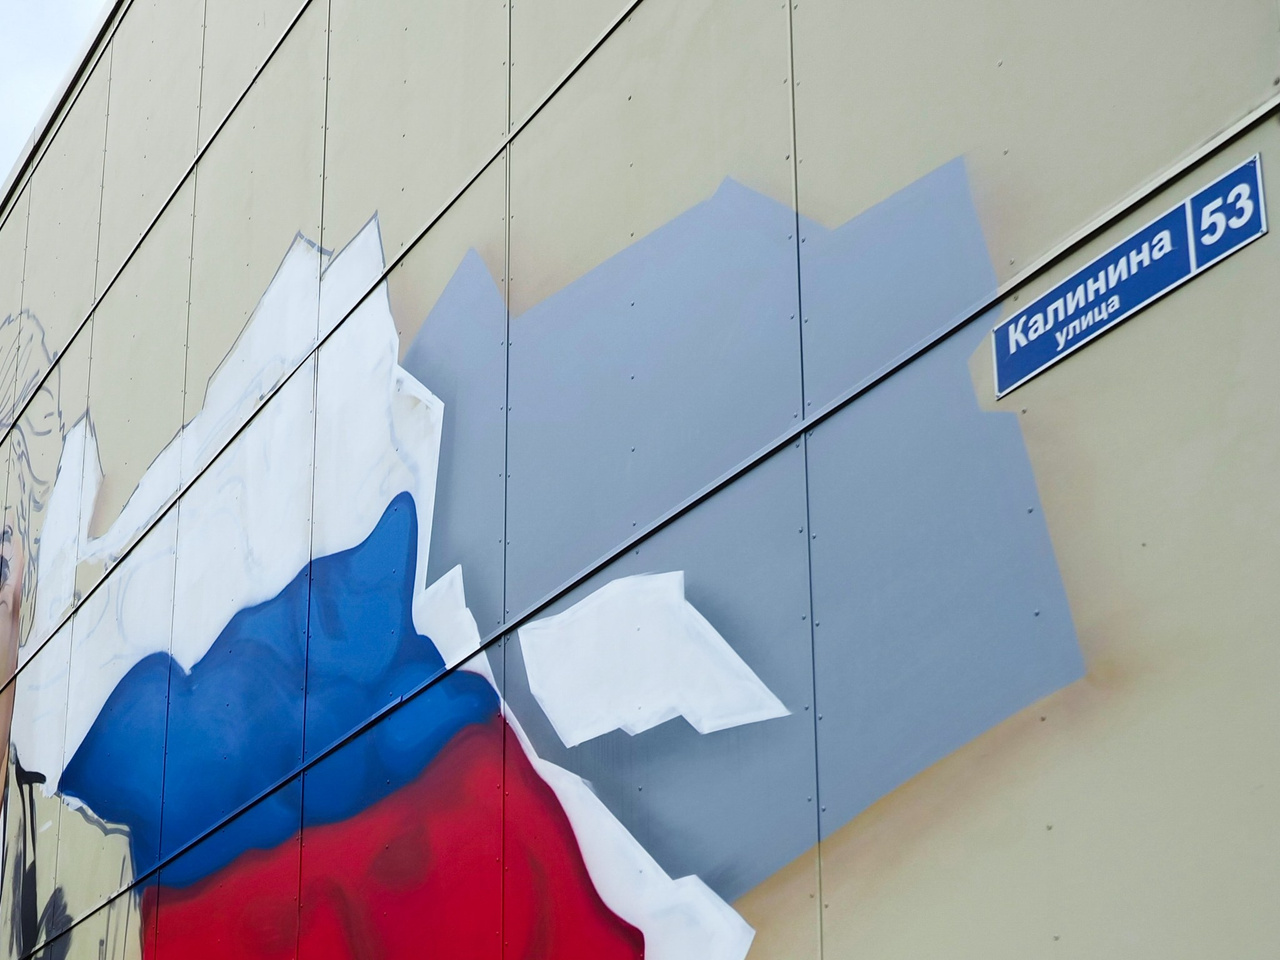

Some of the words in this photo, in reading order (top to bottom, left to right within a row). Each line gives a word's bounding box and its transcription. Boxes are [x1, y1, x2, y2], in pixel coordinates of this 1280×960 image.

[1007, 229, 1173, 355] Калинина
[1200, 183, 1254, 246] 53
[1054, 294, 1120, 352] улица
